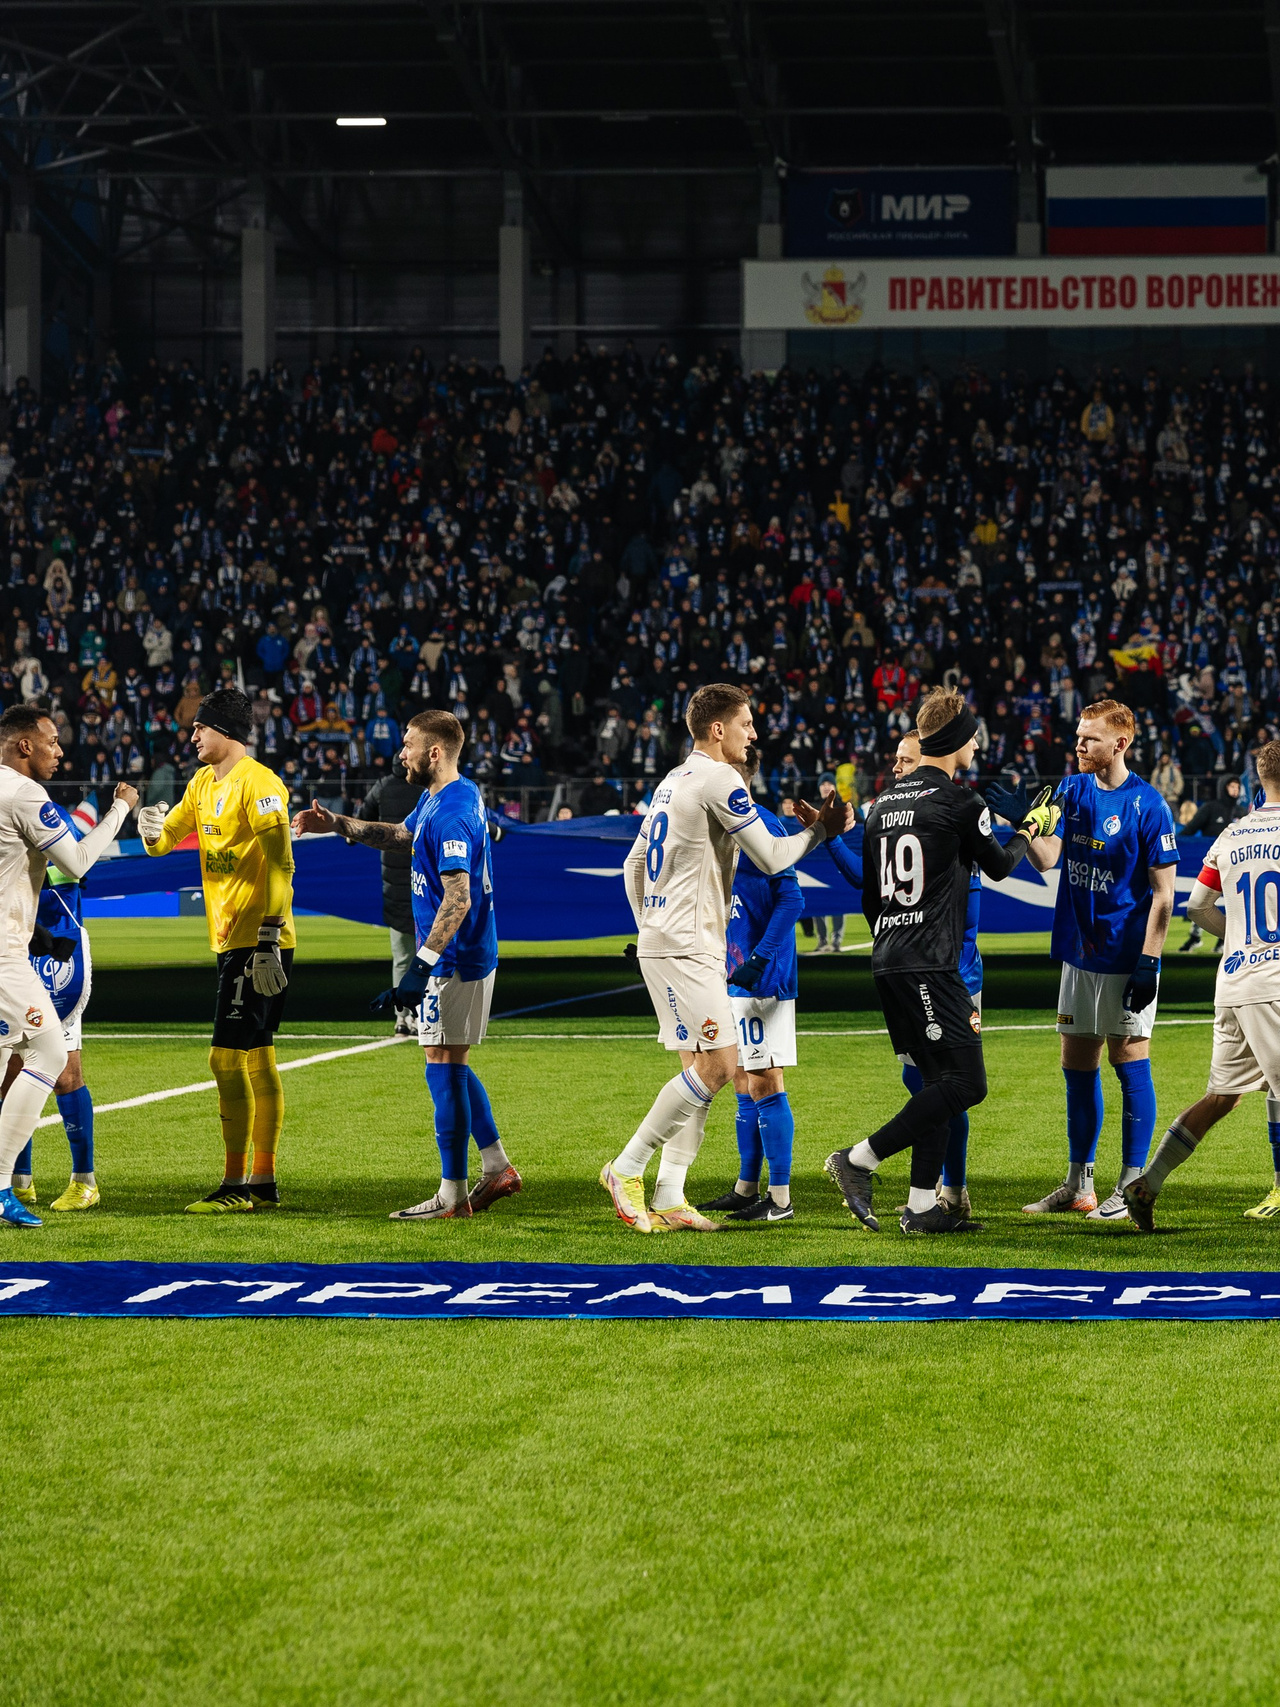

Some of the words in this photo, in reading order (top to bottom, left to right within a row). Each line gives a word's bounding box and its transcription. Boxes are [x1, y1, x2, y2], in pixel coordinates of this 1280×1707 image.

[882, 194, 972, 221] МИР
[889, 276, 1138, 311] ПРАВИТЕЛЬСТВО
[877, 790, 921, 805] АЭРОФЛОТ
[880, 810, 915, 830] ТОРОП
[880, 832, 925, 907] 49
[231, 975, 246, 1007] 1
[919, 983, 936, 1023] РОССЕТИ
[420, 995, 440, 1024] 13
[739, 1016, 765, 1046] 10
